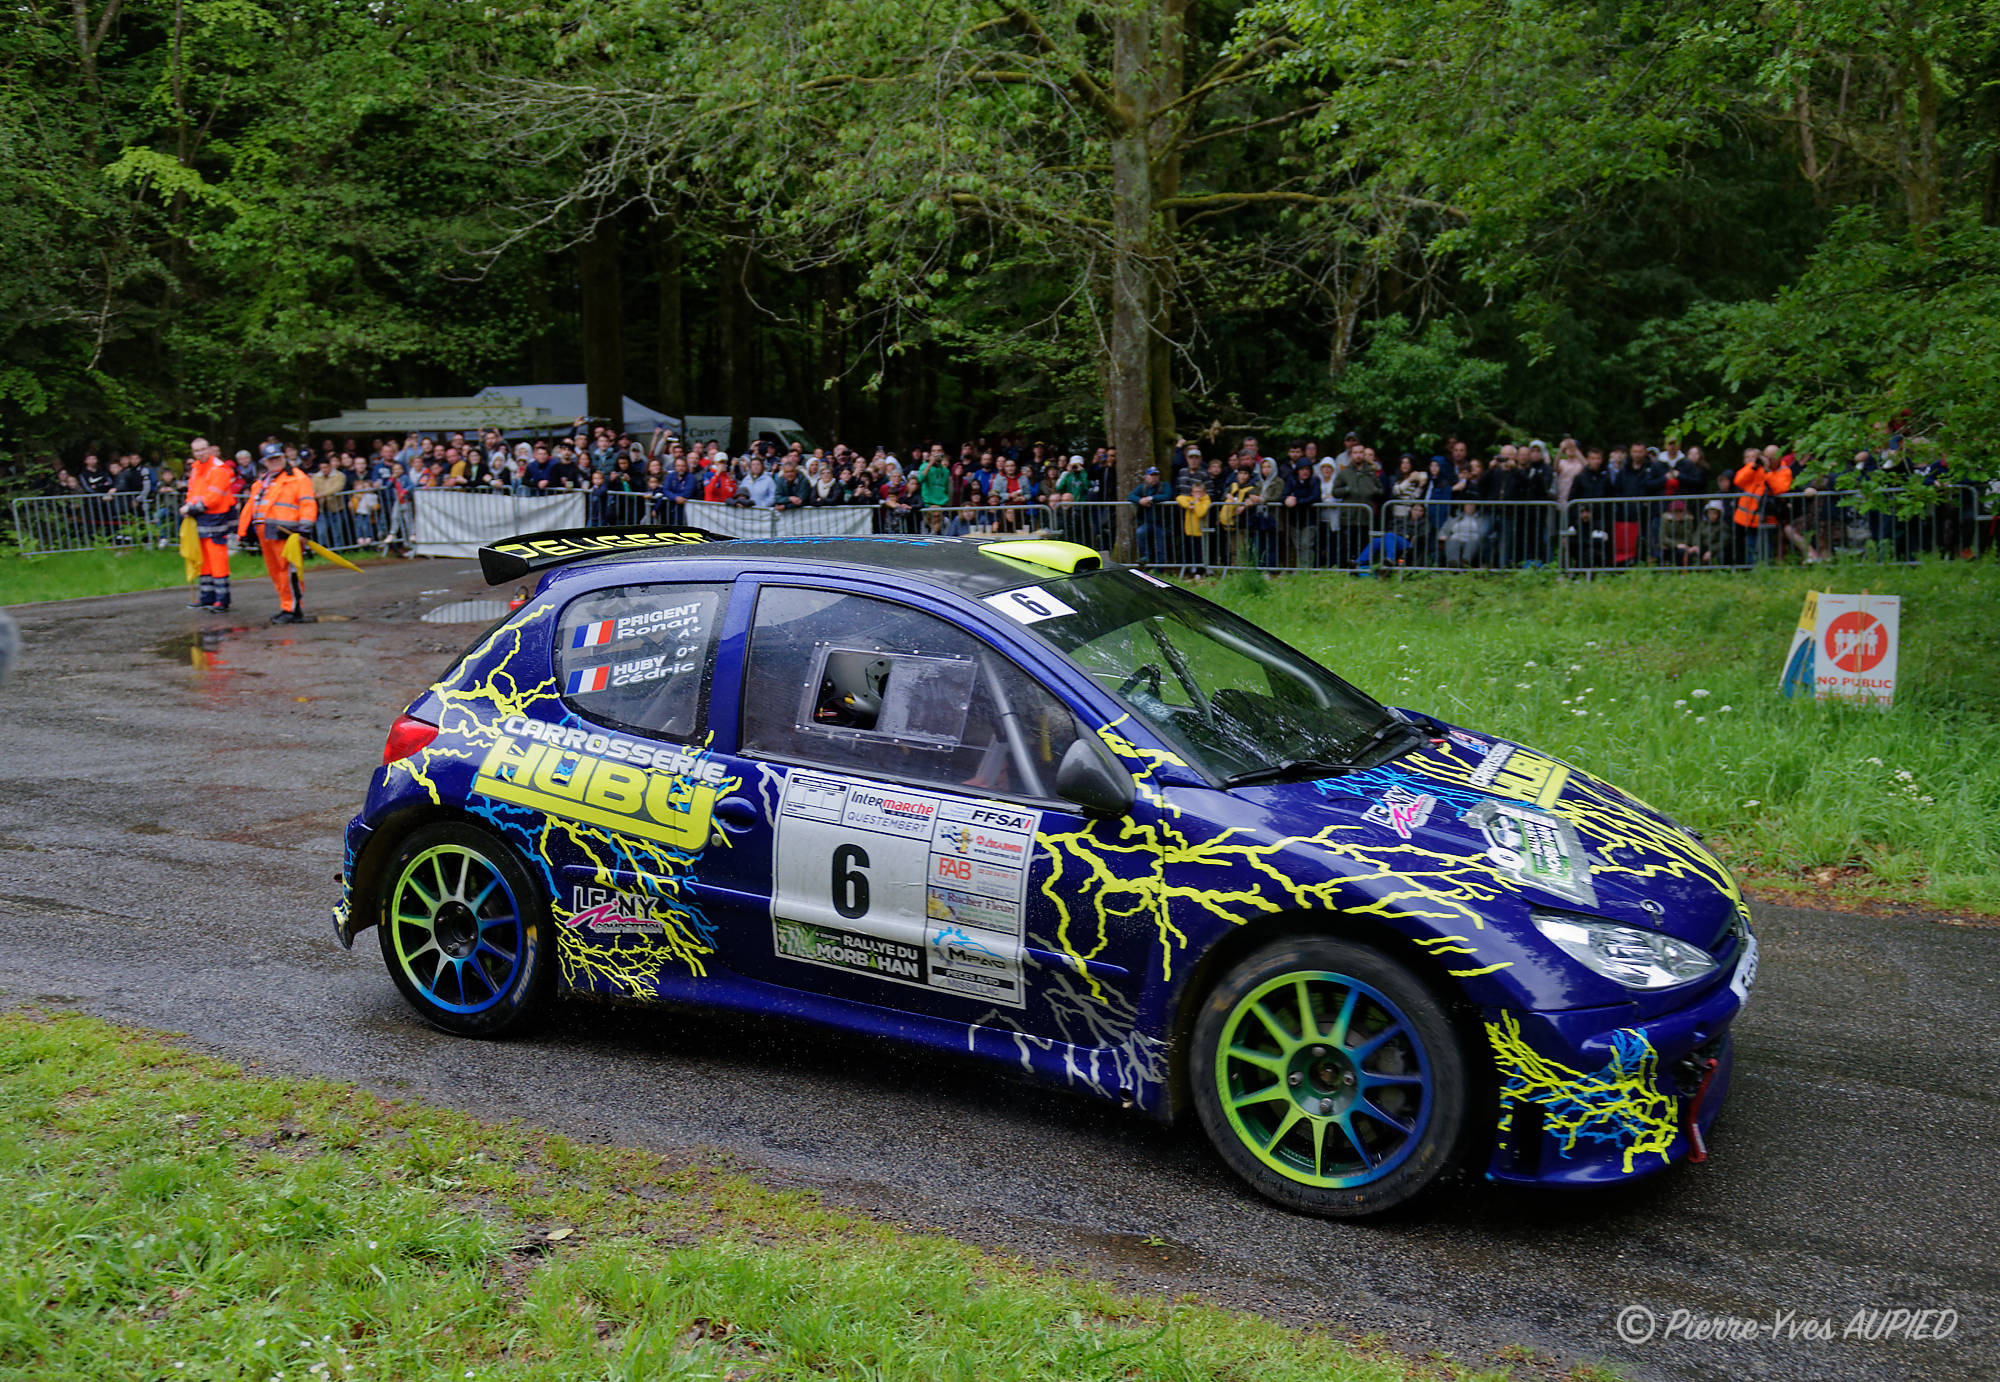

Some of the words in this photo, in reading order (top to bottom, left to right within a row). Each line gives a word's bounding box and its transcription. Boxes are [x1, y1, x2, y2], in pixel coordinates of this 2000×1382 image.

[618, 603, 701, 629] PRIGENT
[1010, 592, 1052, 616] 6
[617, 616, 699, 639] Ronan
[678, 626, 701, 639] A+
[612, 662, 695, 686] Cédric
[613, 655, 667, 677] HUBY
[1817, 676, 1838, 686] NO
[1841, 677, 1893, 689] PUBLIC
[504, 715, 727, 783] CARROSSERIE
[473, 734, 717, 850] HUBY
[851, 791, 934, 816] Intermarché
[847, 811, 928, 833] QUESTEMBERT
[971, 810, 1022, 829] FFSA
[938, 857, 972, 880] FAB
[832, 843, 870, 919] 6
[842, 935, 896, 956] RALLYE
[897, 946, 918, 960] DU
